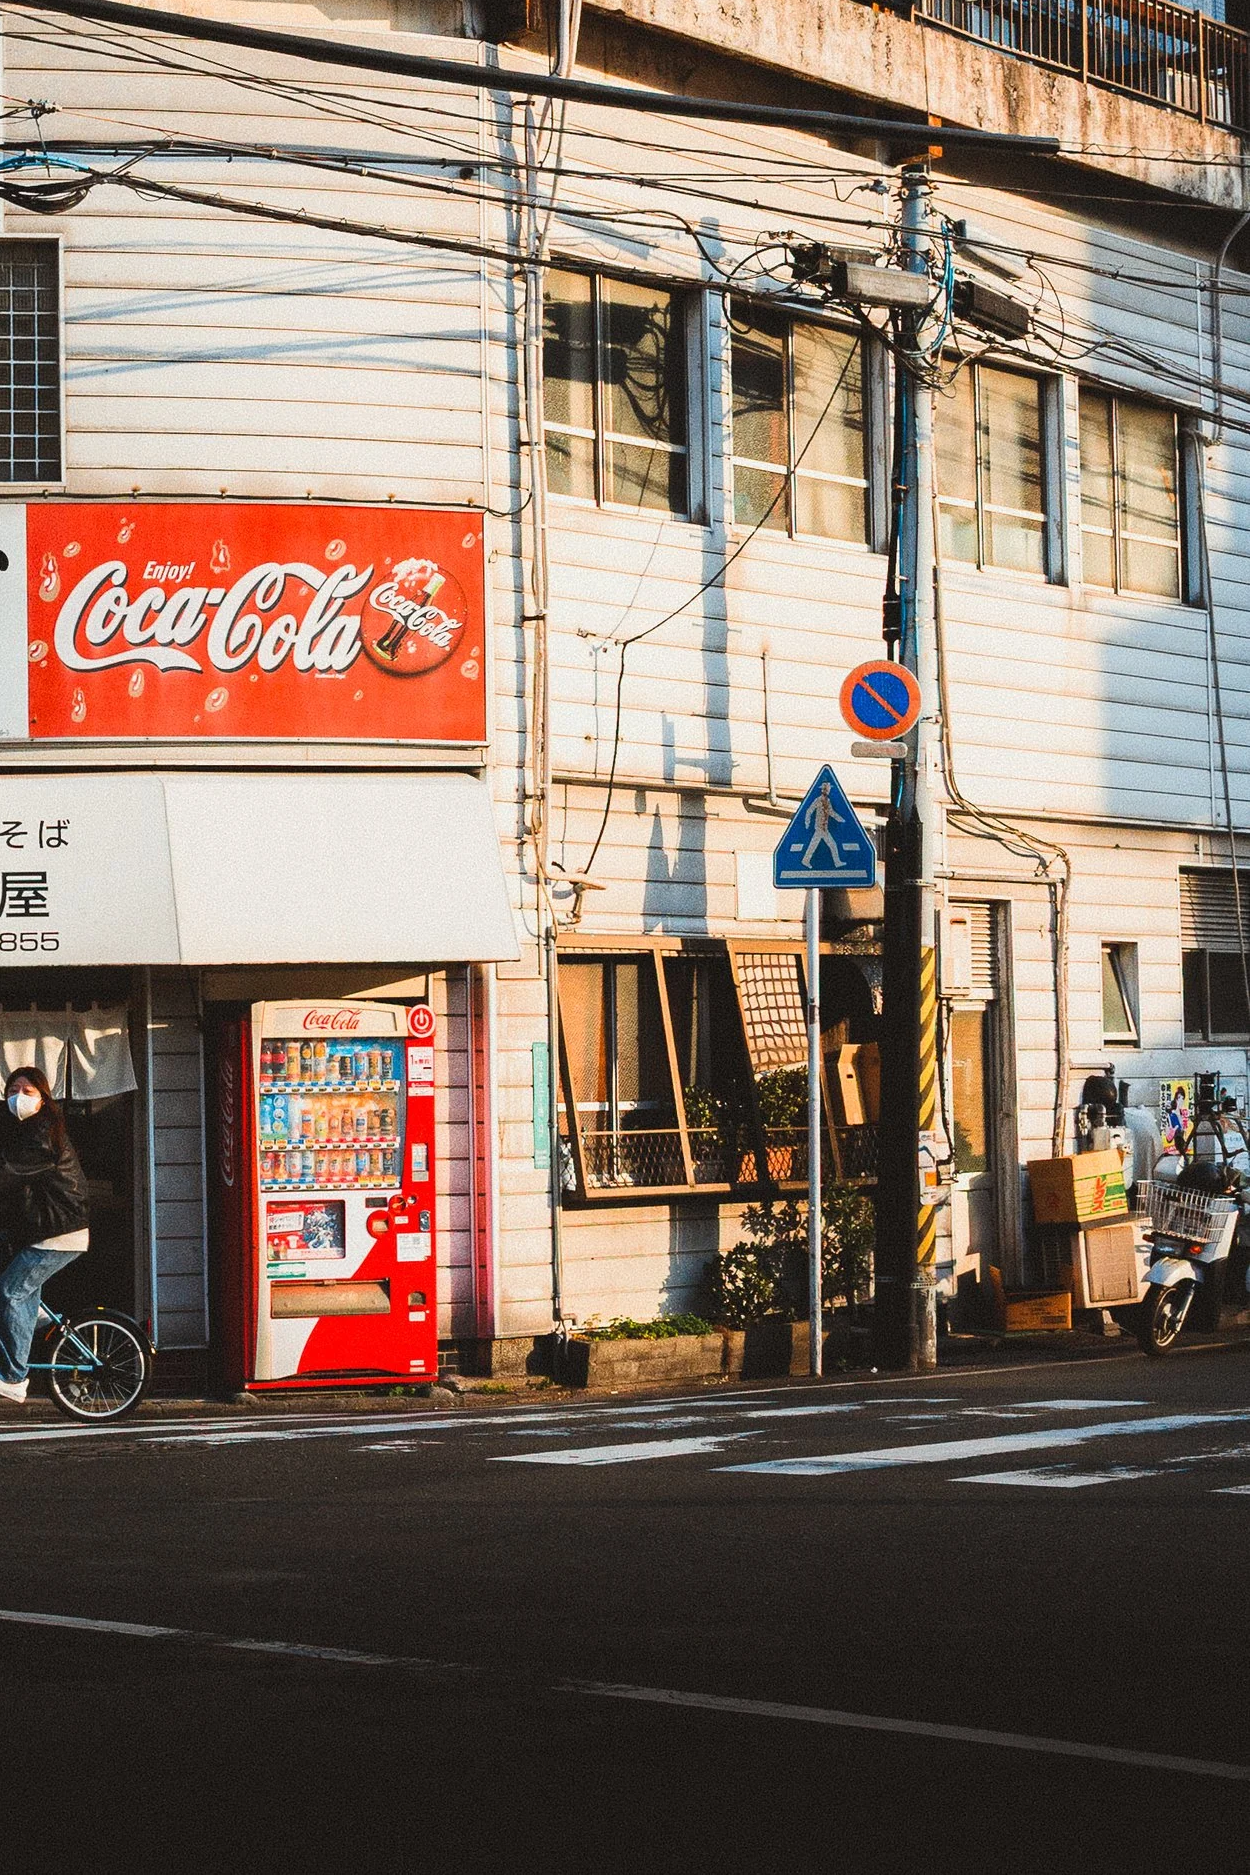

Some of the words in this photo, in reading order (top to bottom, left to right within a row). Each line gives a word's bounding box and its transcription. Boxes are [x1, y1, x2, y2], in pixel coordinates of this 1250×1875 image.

[143, 560, 196, 582] Enjoy!
[54, 559, 374, 674] Coca-Cola
[368, 581, 463, 651] Coca-Cola
[303, 1009, 362, 1030] Coca-Cola
